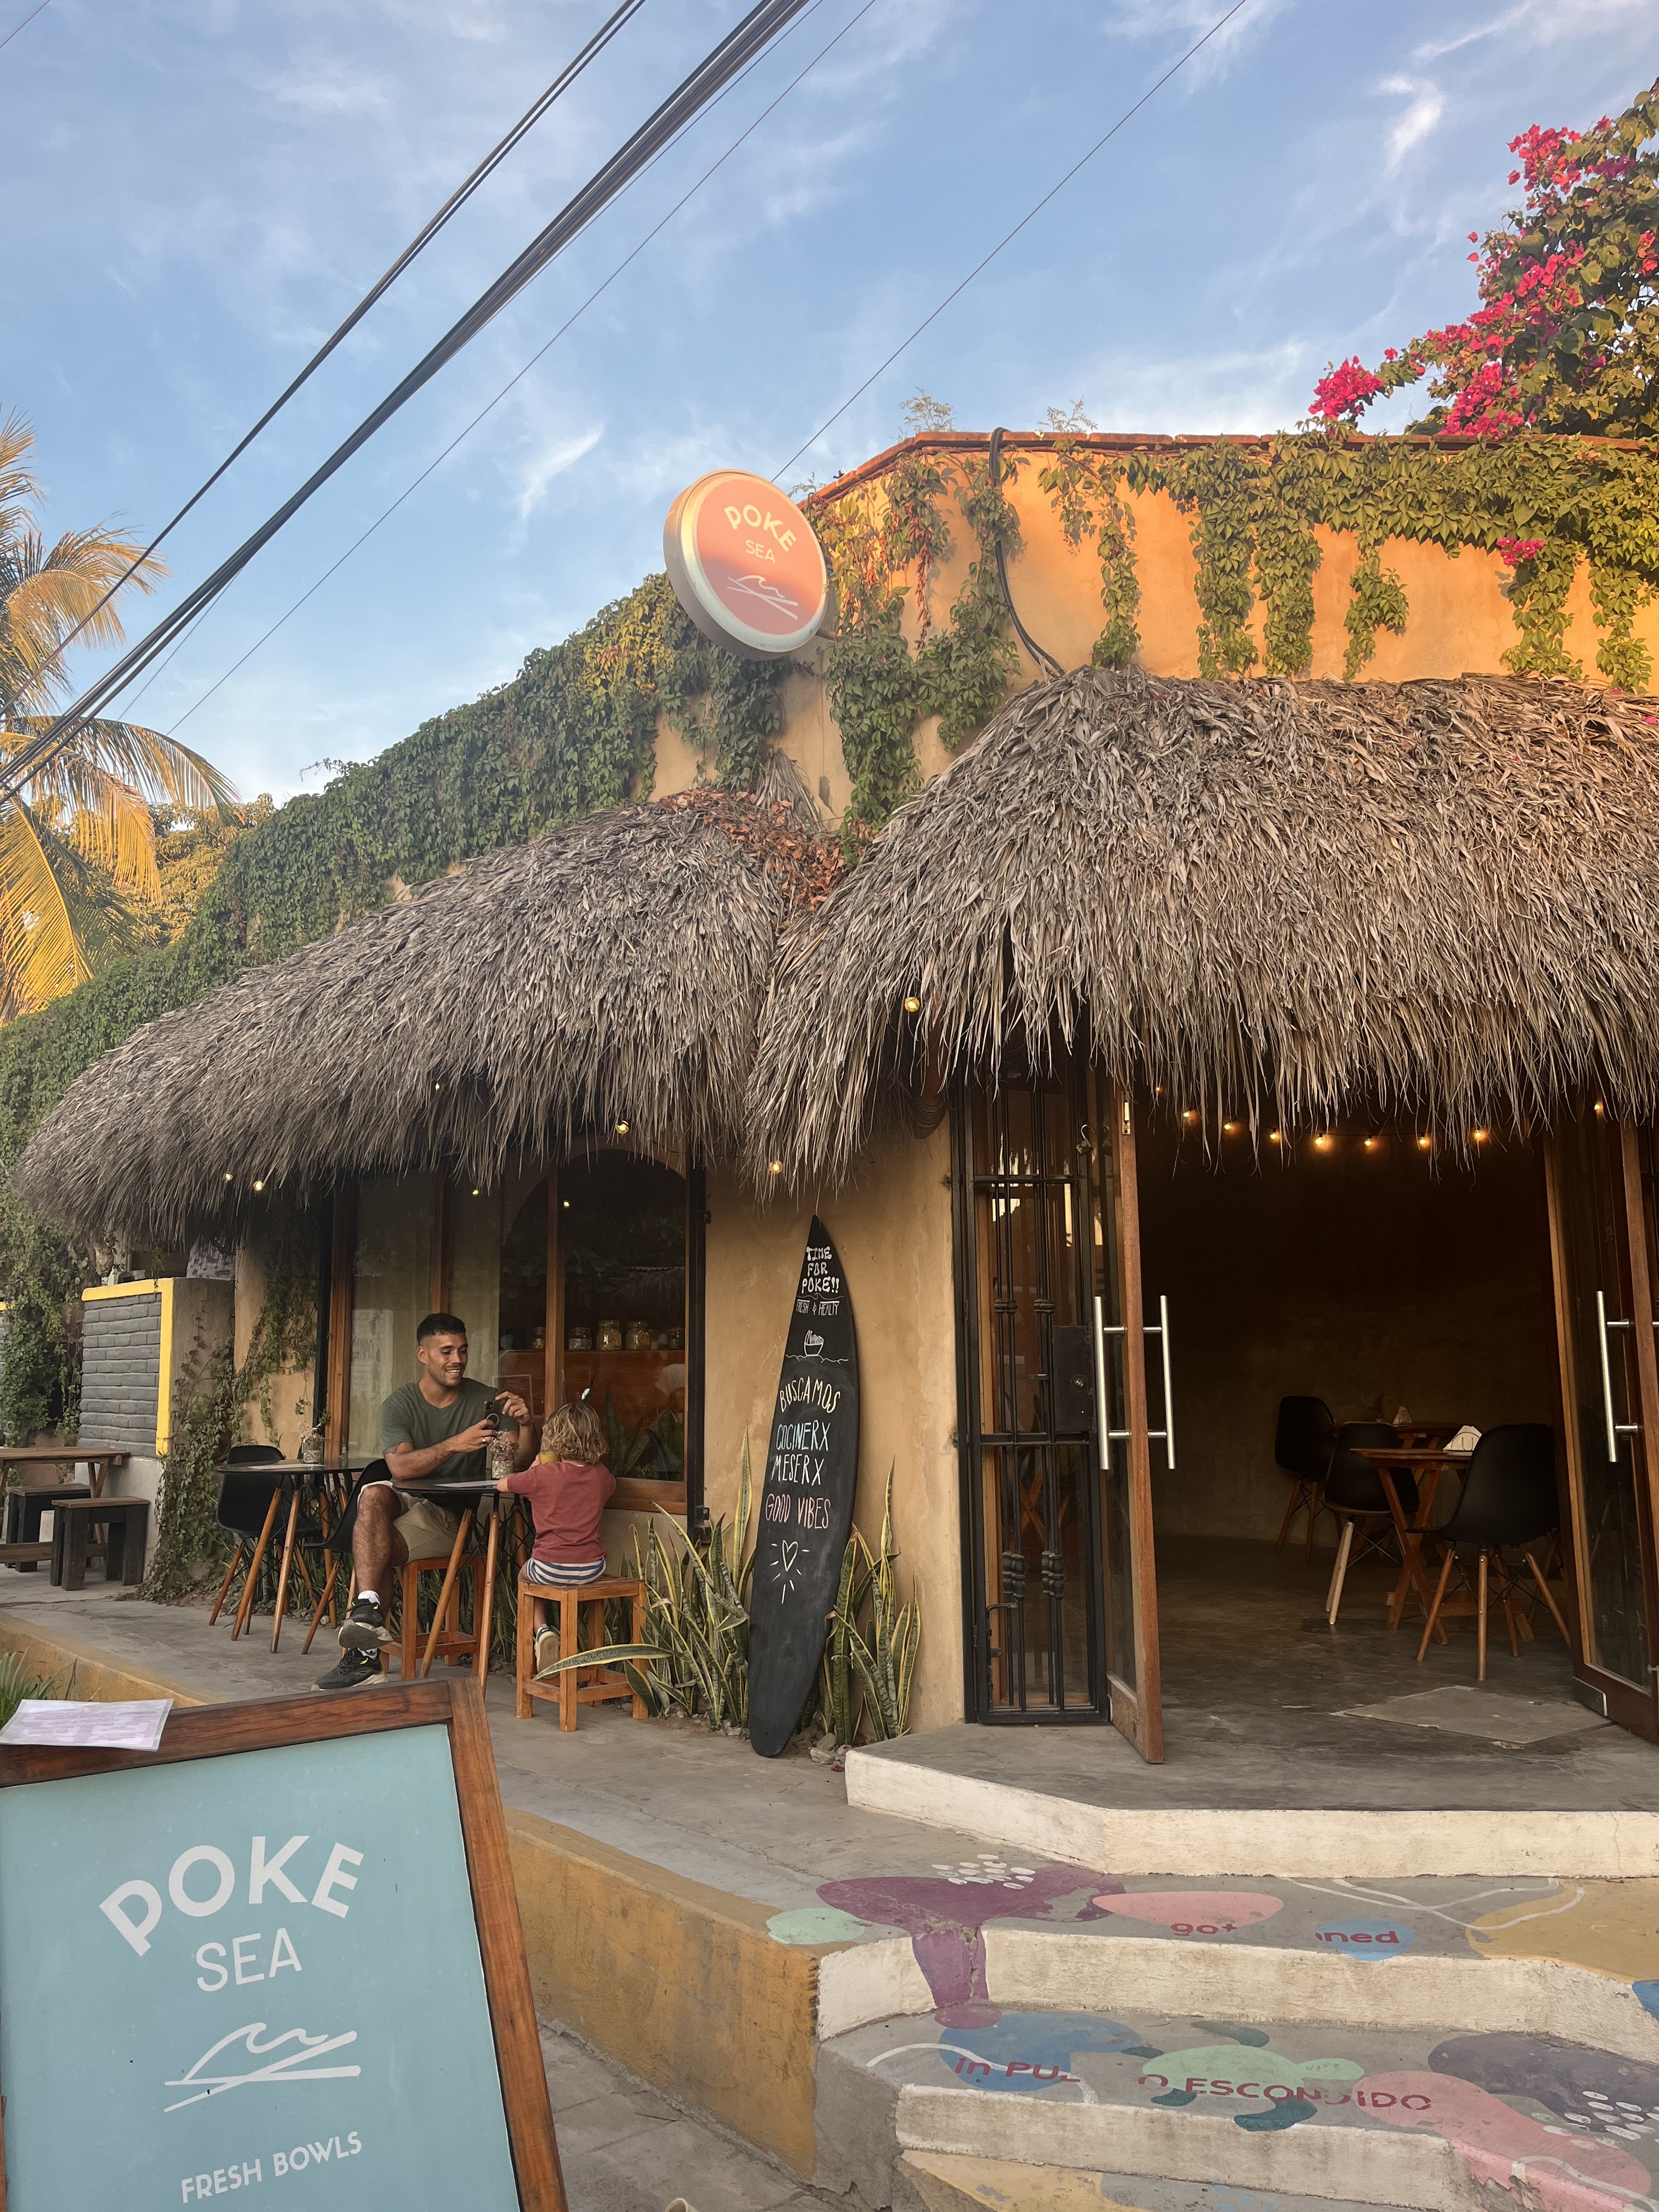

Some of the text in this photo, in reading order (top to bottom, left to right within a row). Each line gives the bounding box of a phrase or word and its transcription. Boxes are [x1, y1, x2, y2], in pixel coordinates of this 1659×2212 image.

[724, 504, 797, 552] POKE
[745, 539, 776, 564] SEA
[806, 1246, 832, 1261] TIME
[807, 1262, 828, 1277] FOR
[801, 1276, 840, 1294] POKE!!
[796, 1299, 810, 1314] FRESH
[812, 1302, 817, 1315] &
[780, 1376, 840, 1413] BUSCAMOS
[776, 1419, 831, 1451] COCINERX
[771, 1454, 824, 1486] MESERX
[765, 1493, 831, 1529] GOOD VIBES
[99, 1835, 364, 1957] POKE
[1314, 1931, 1400, 1943] ned
[195, 1928, 302, 1992] SEA
[955, 2058, 991, 2075] in
[181, 2131, 362, 2204] FRESH BOWLS
